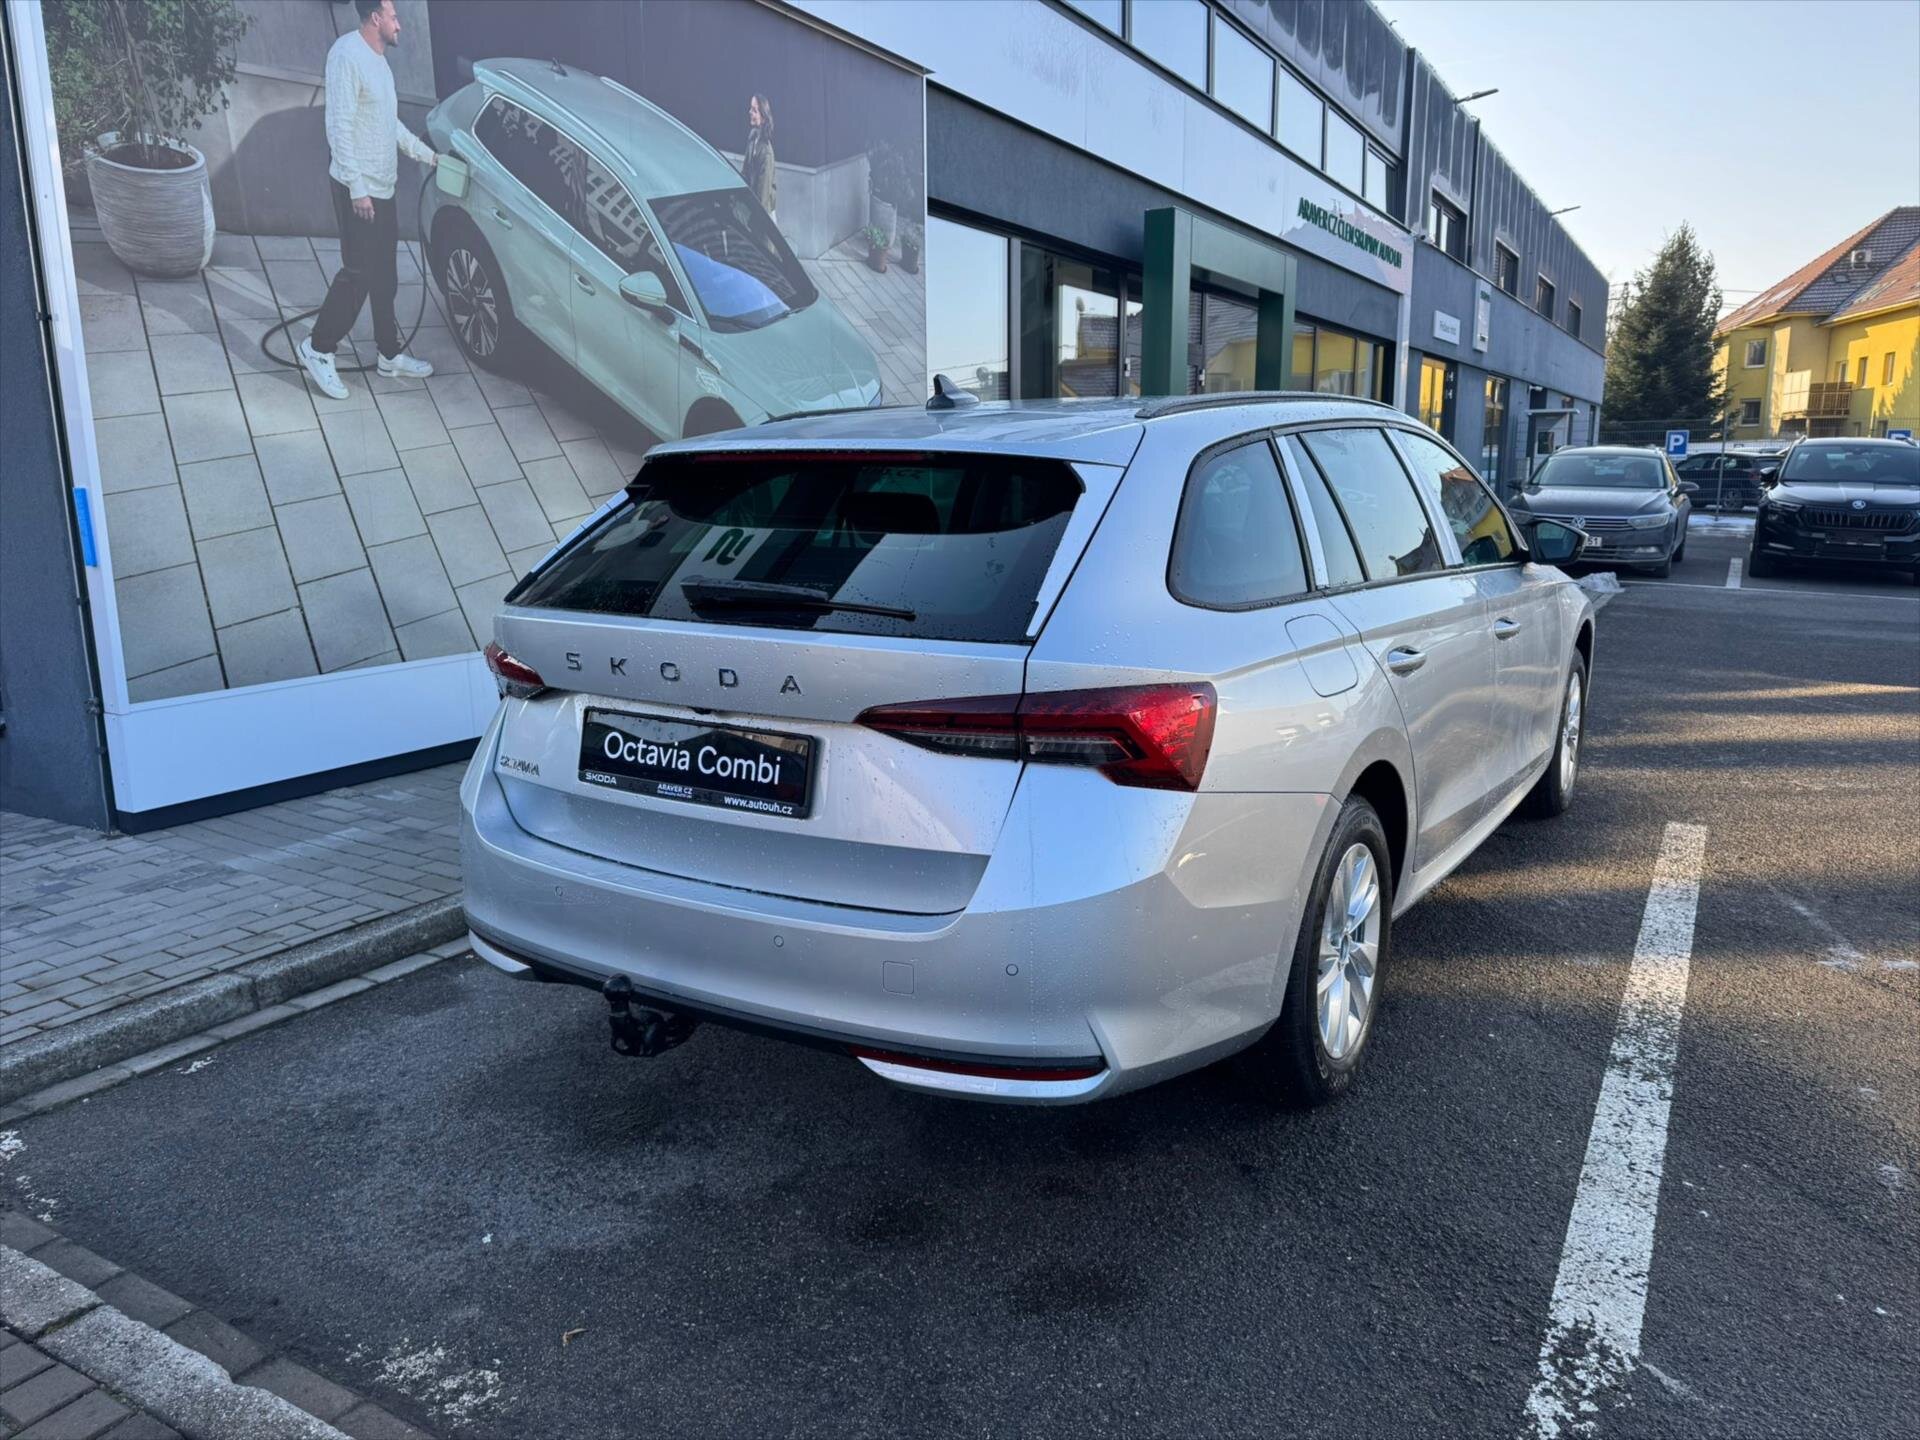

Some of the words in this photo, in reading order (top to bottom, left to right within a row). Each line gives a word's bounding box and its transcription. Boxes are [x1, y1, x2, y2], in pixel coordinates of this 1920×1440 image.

[1669, 434, 1685, 451] P
[604, 731, 690, 771] Octavia
[697, 745, 781, 785] Combi
[724, 795, 793, 816] www.autouh.cz
